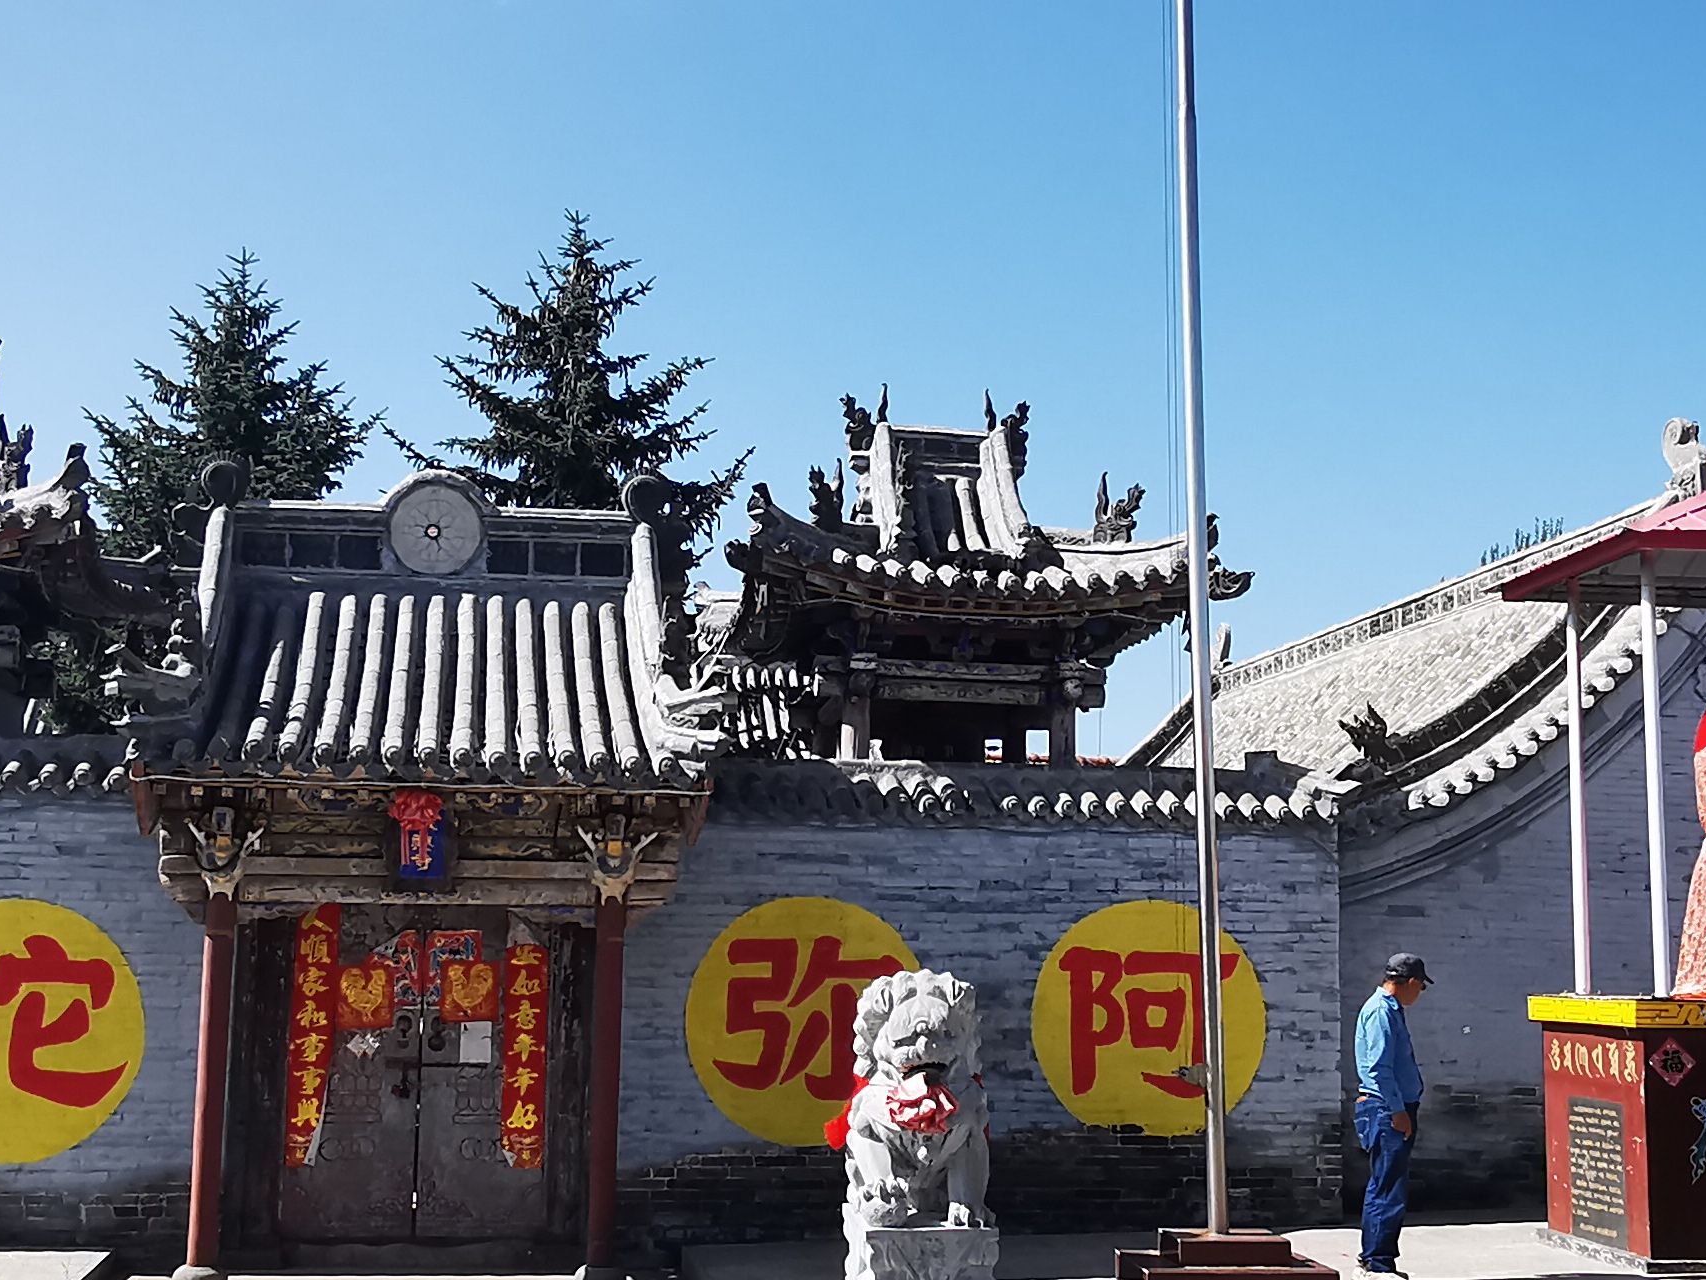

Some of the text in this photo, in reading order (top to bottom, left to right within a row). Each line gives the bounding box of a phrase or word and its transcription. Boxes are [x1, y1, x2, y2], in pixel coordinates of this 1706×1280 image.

[712, 935, 905, 1102] 弥
[1058, 946, 1240, 1099] 阿
[1659, 1049, 1686, 1074] 福
